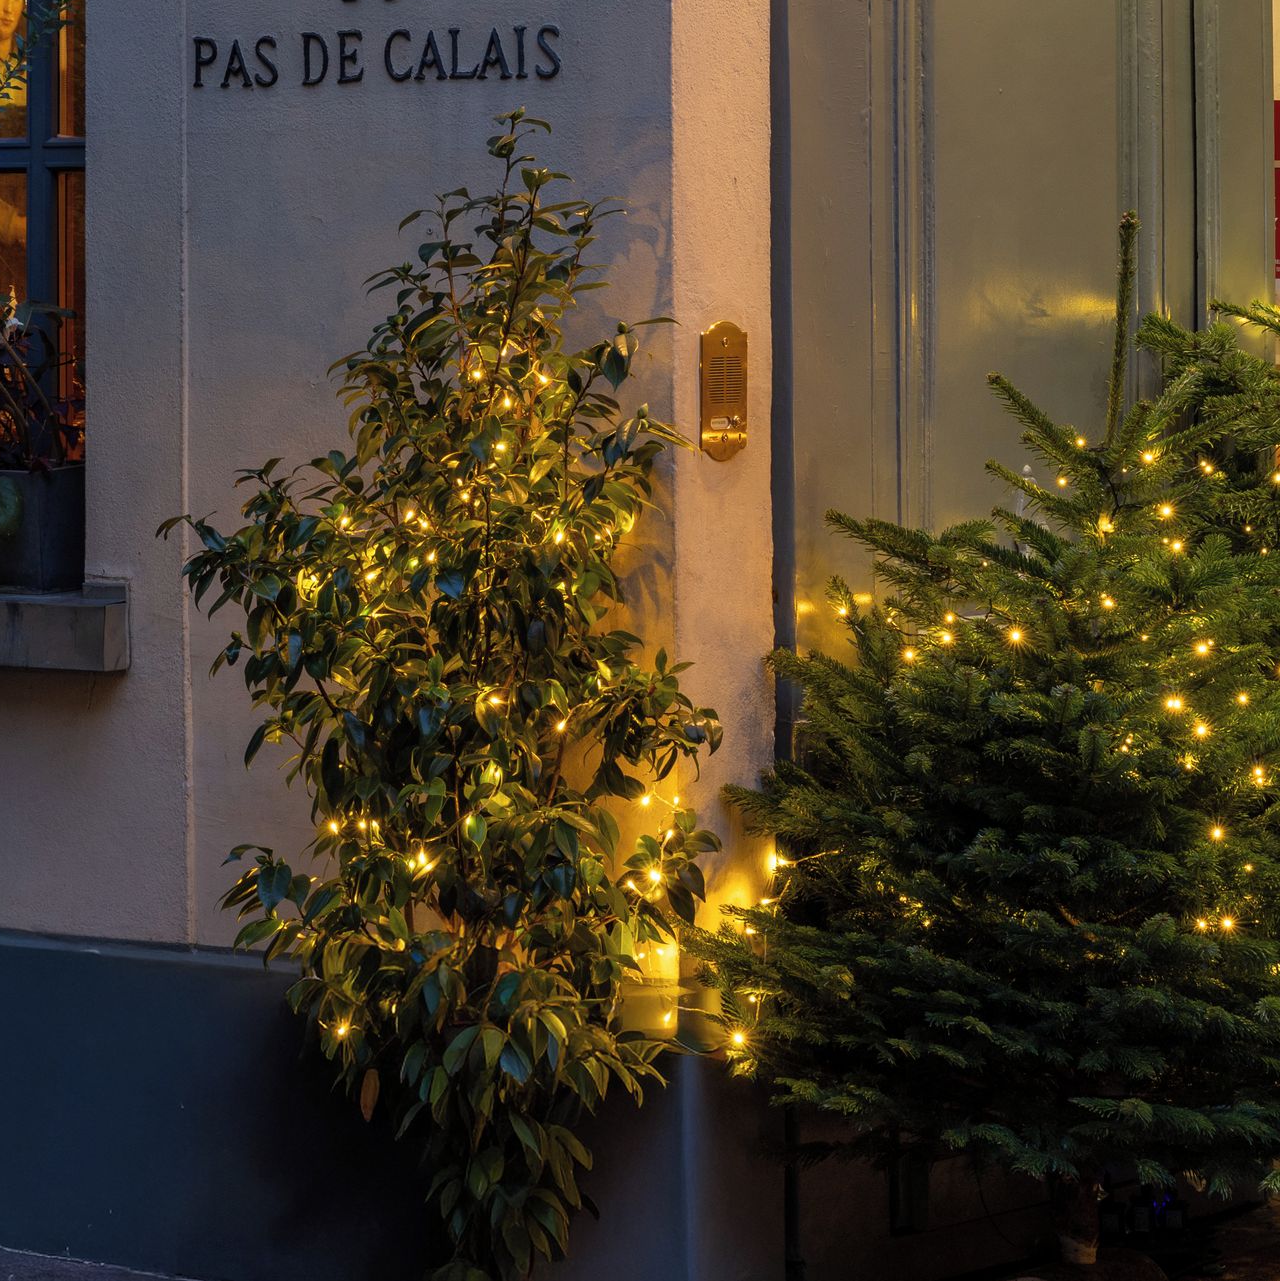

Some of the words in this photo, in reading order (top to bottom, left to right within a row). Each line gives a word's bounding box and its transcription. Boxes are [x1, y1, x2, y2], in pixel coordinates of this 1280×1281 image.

[193, 35, 278, 88] PAS
[302, 29, 364, 85] DE
[384, 24, 561, 81] CALAIS
